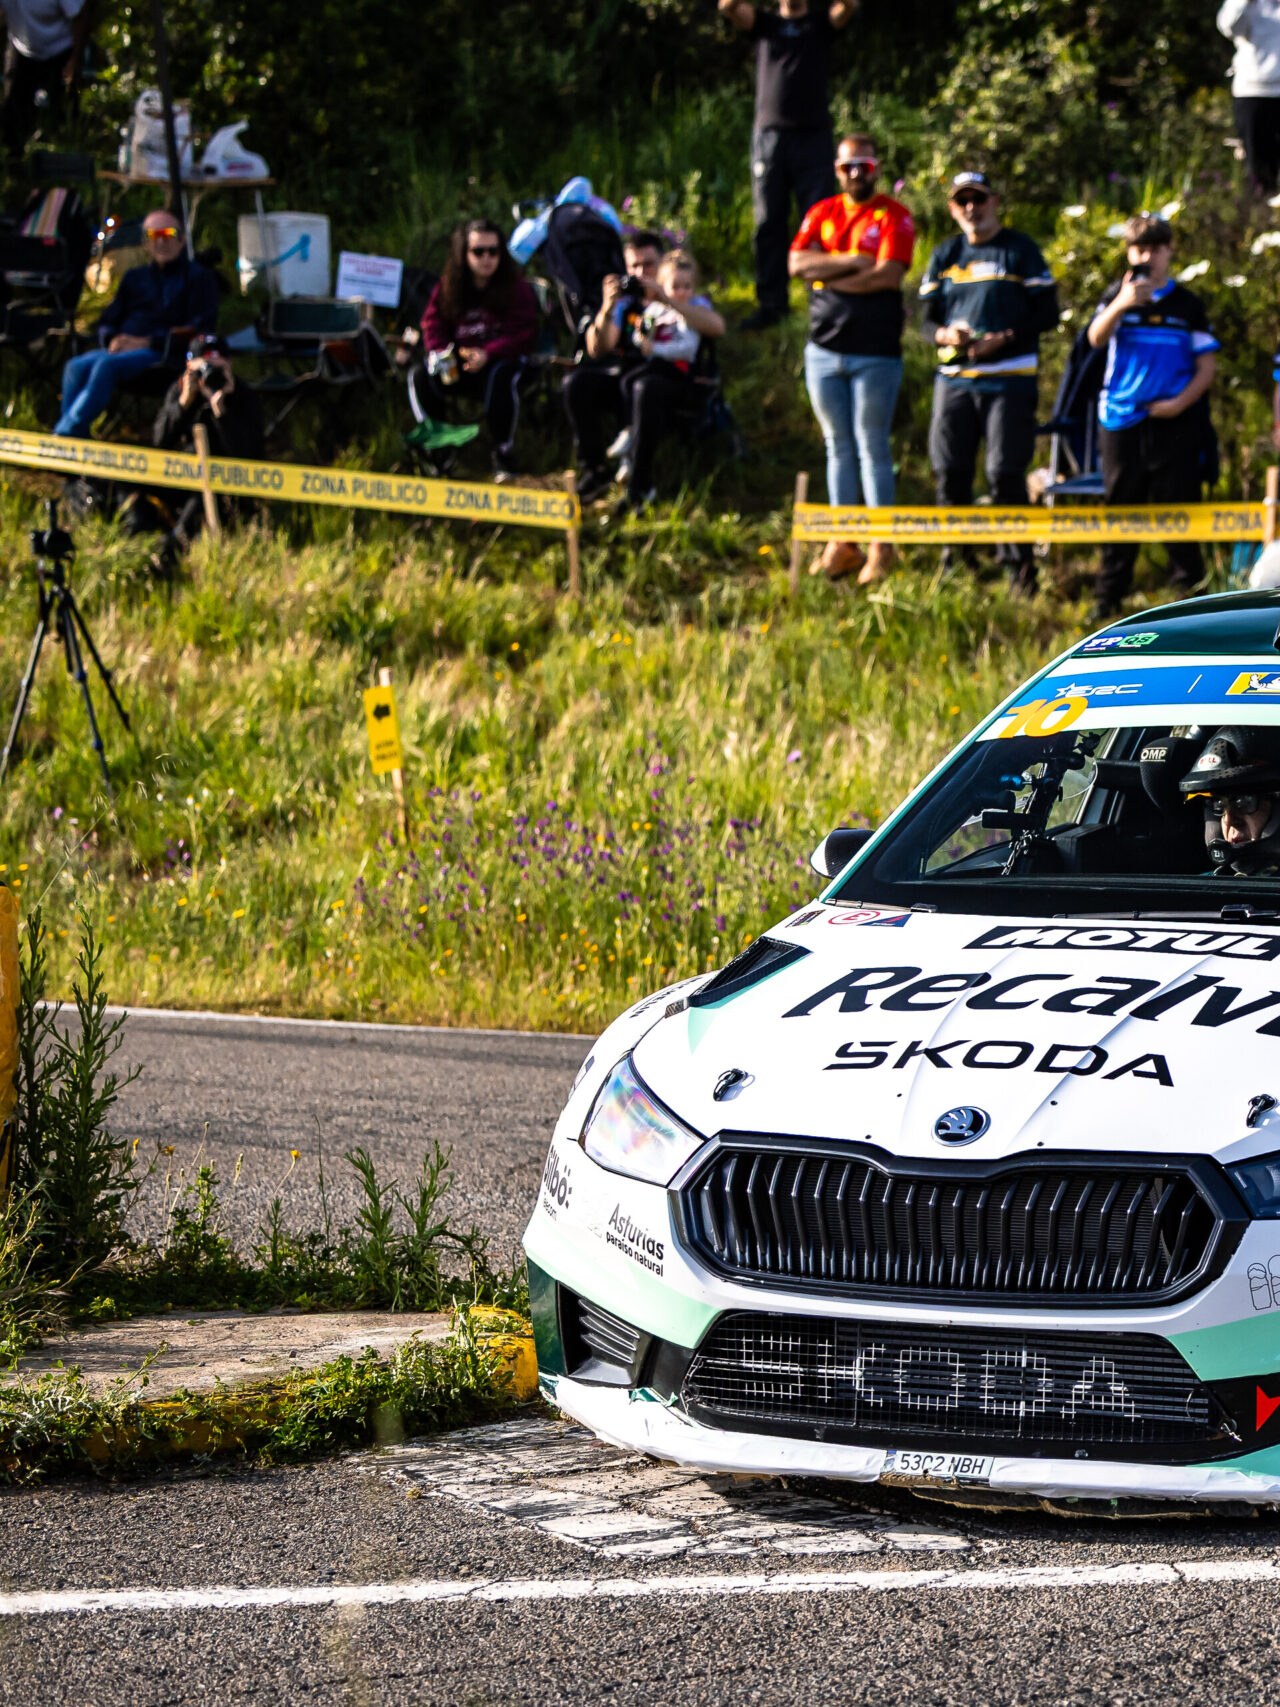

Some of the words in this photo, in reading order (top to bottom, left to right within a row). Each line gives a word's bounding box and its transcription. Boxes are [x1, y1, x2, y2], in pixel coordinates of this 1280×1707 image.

[39, 439, 77, 461] ZONA
[82, 446, 148, 474] PUBLICO
[164, 458, 203, 479] ZONA
[210, 463, 284, 490] PUBLICO
[301, 472, 348, 495] ZONA
[352, 477, 427, 506] PUBLICO
[445, 486, 493, 512] ZONA
[497, 494, 575, 521] PUBLICO
[801, 511, 870, 534] UBLICO
[891, 514, 941, 534] ZONA
[946, 514, 1029, 535] PUBLICO
[1050, 514, 1100, 534] ZONA
[1106, 511, 1190, 534] PUBLICO
[1212, 510, 1263, 533] ZONA
[998, 695, 1089, 739] 10
[1140, 749, 1167, 761] OMP
[981, 926, 1278, 956] MOTUL
[822, 1039, 1175, 1087] SKODA
[608, 1202, 664, 1260] Asturias
[634, 1250, 664, 1277] natural
[742, 1335, 1141, 1423] SKODA
